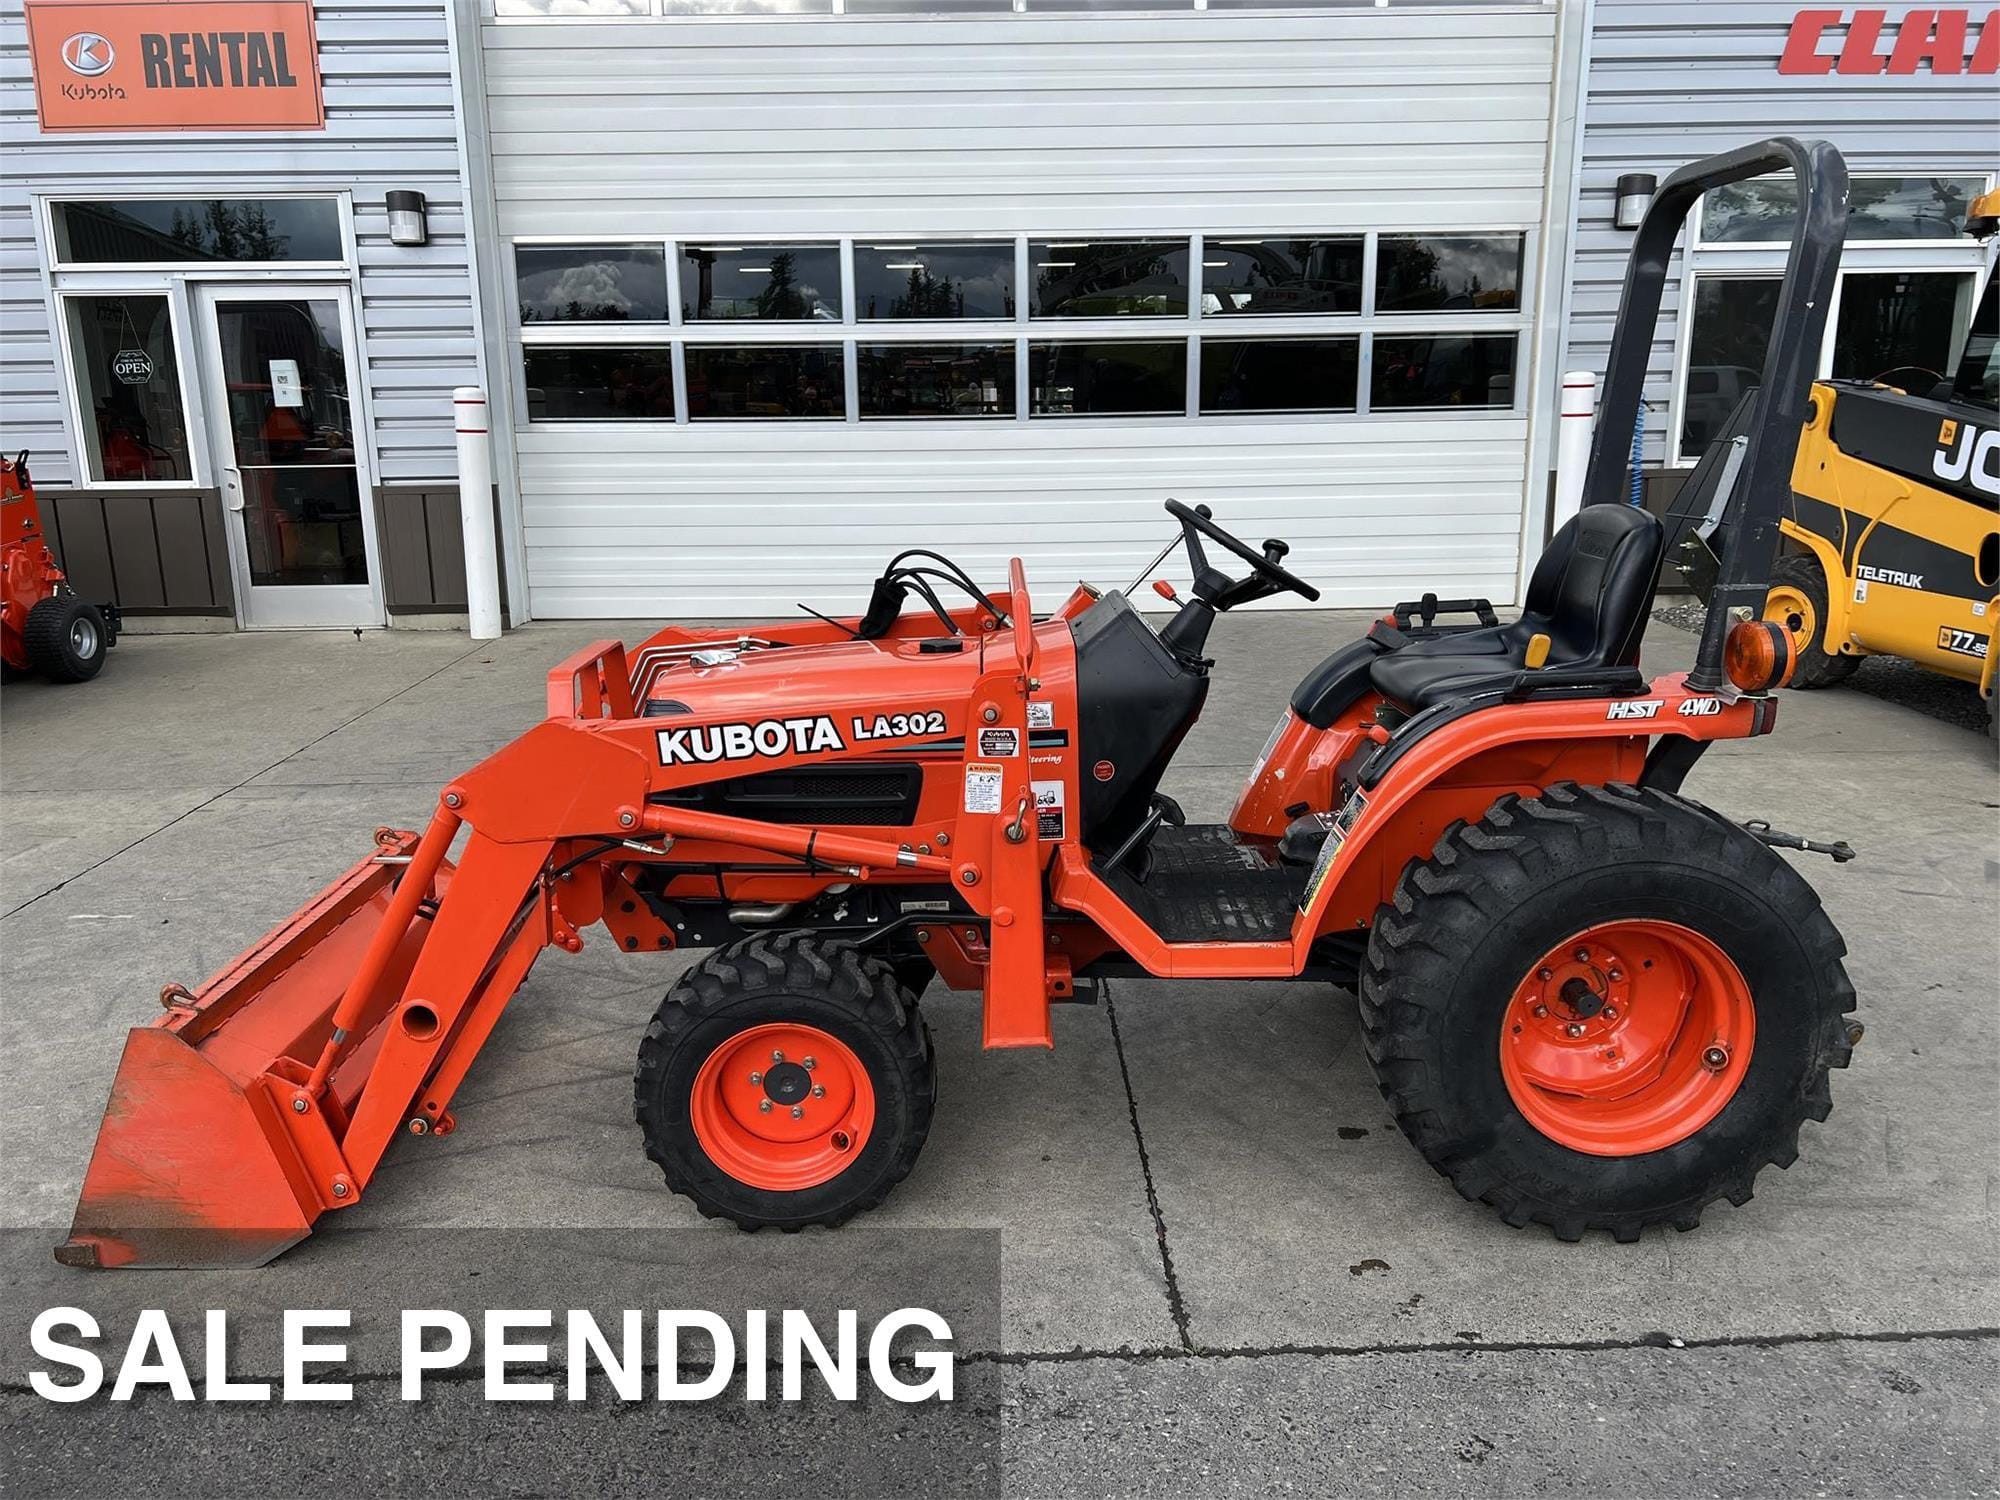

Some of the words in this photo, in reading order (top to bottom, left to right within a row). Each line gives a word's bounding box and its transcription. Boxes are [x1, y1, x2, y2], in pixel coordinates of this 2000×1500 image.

[141, 32, 297, 88] RENTAL
[62, 83, 126, 100] Kubota
[115, 362, 151, 374] OPEN
[1857, 565, 1923, 588] TELETRUK
[1607, 700, 1664, 719] HST
[1678, 698, 1721, 716] 4WD
[657, 716, 845, 765] KUBOTA
[853, 712, 945, 741] LA302
[1029, 753, 1062, 764] teering
